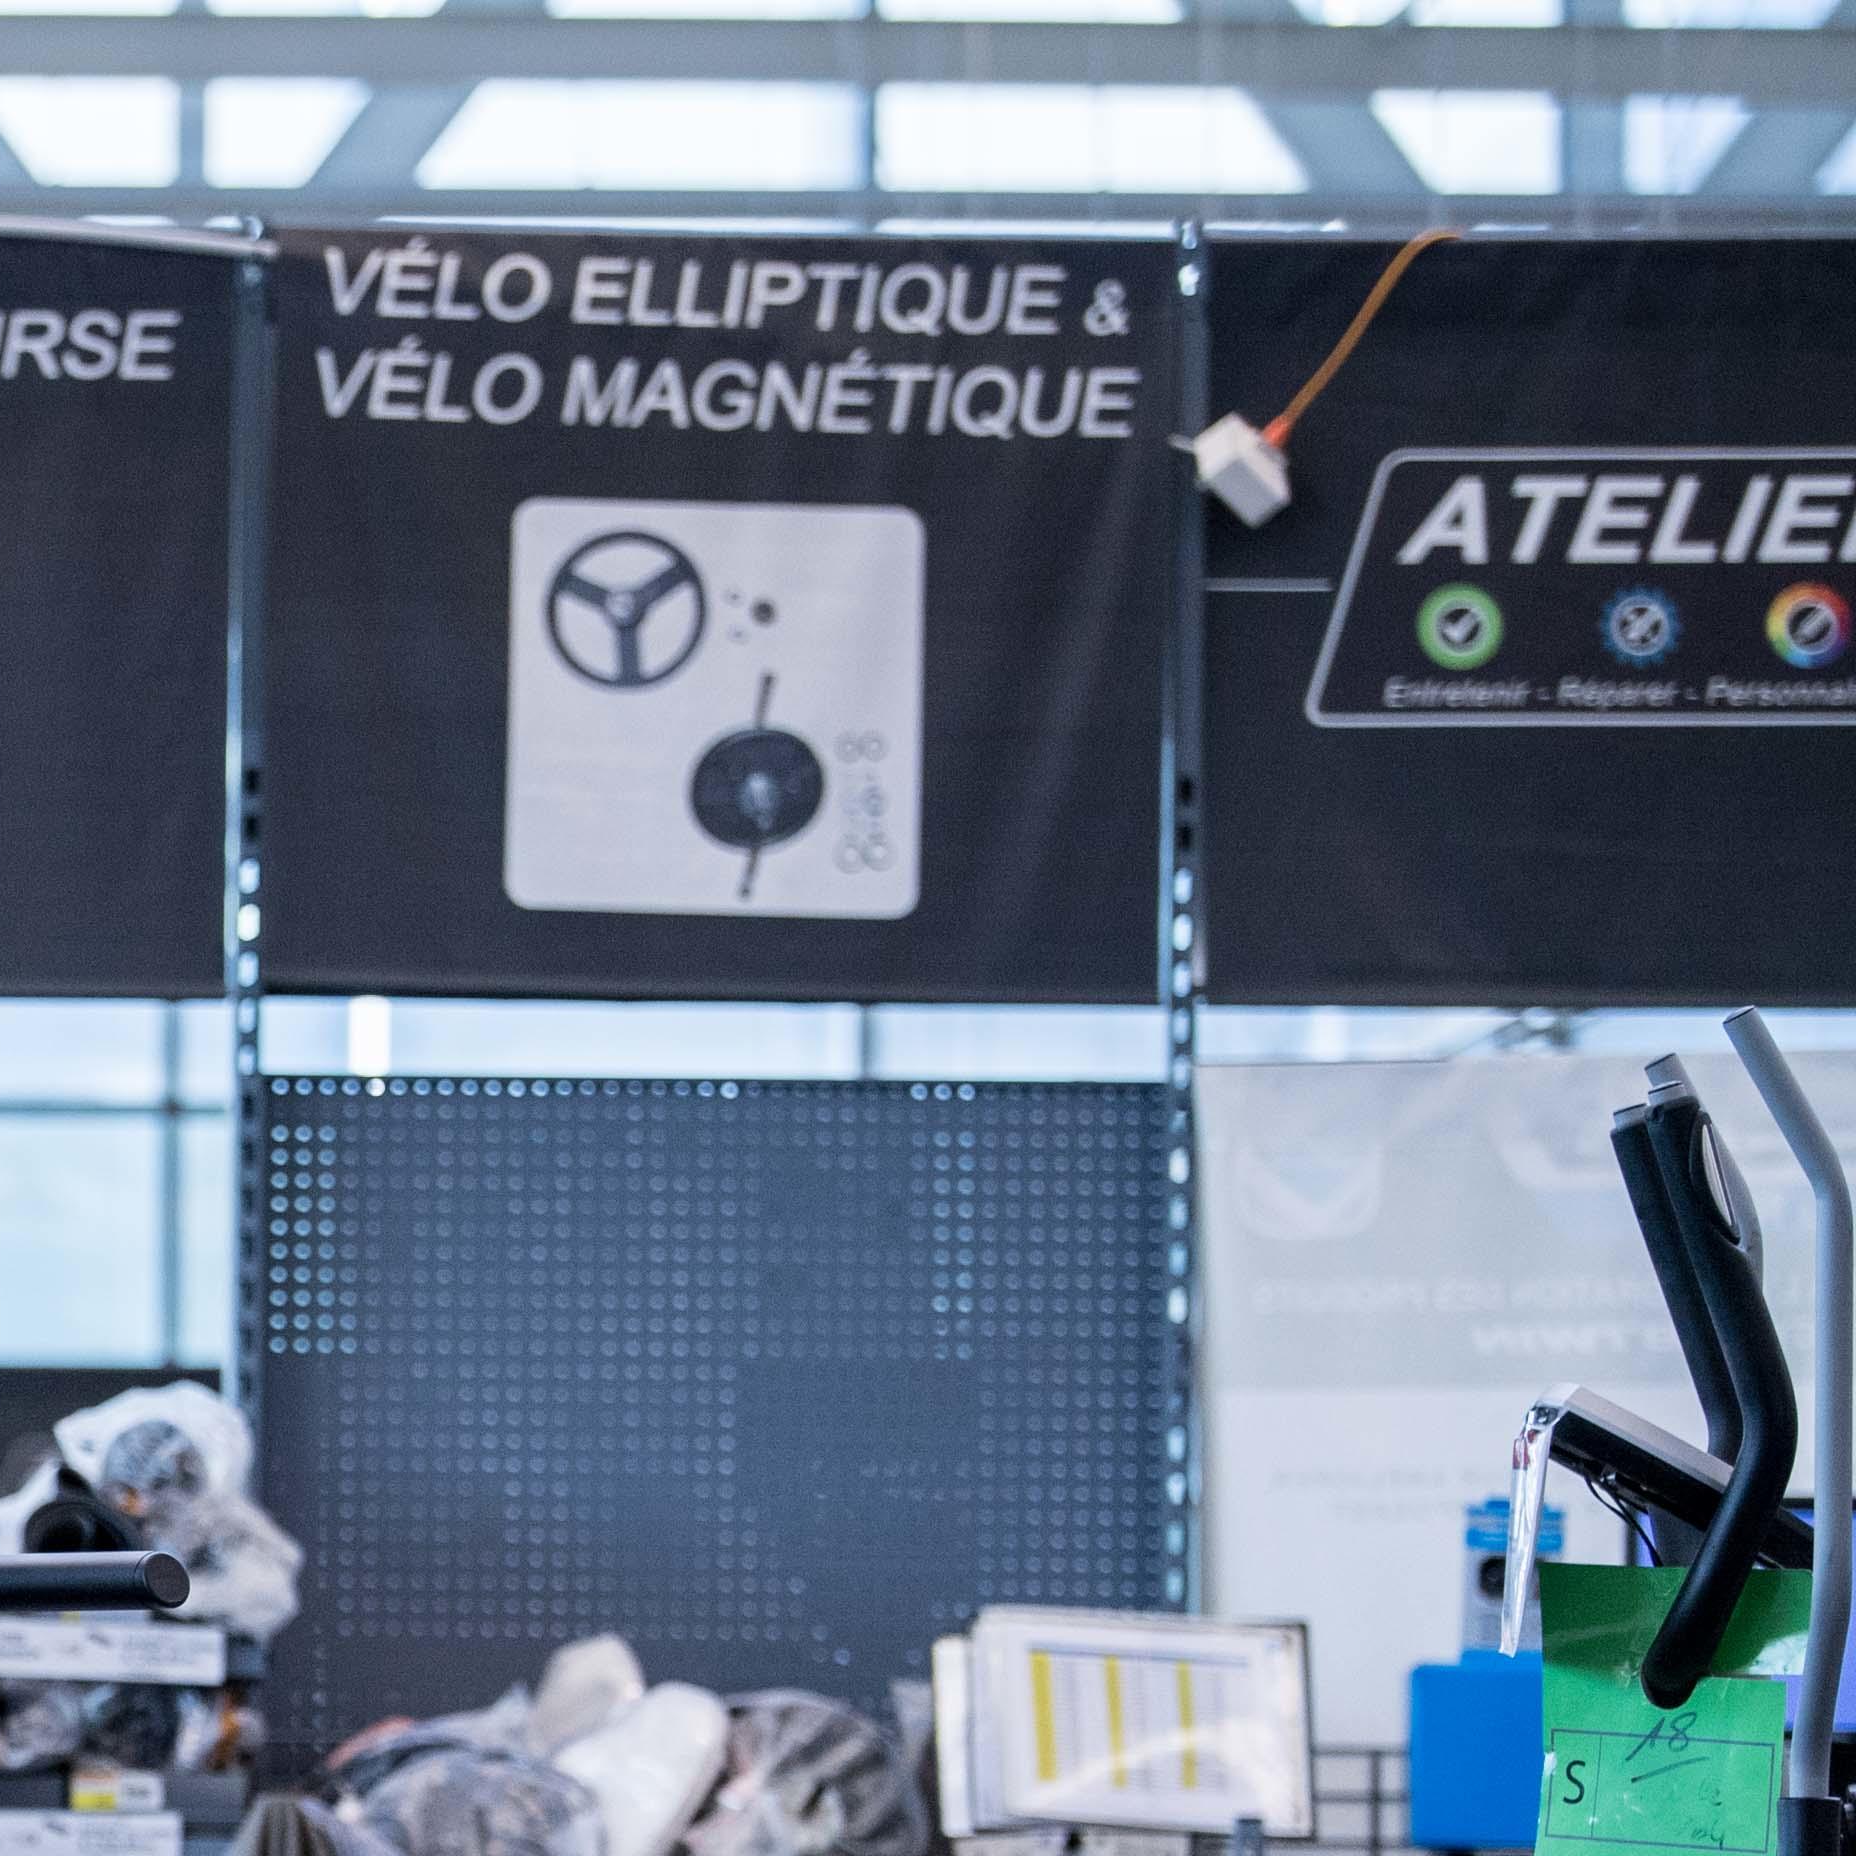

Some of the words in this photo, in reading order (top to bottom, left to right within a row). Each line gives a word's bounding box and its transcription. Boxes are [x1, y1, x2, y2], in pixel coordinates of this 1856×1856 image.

[322, 236, 550, 324] VÉLO
[570, 256, 1067, 337] ELLIPTIQUE
[1084, 279, 1129, 337] &
[313, 336, 543, 425] VÉLO
[560, 349, 1140, 441] MAGNÉTIQUE
[1396, 473, 1856, 564] ATELIE
[1562, 1759, 1587, 1805] S
